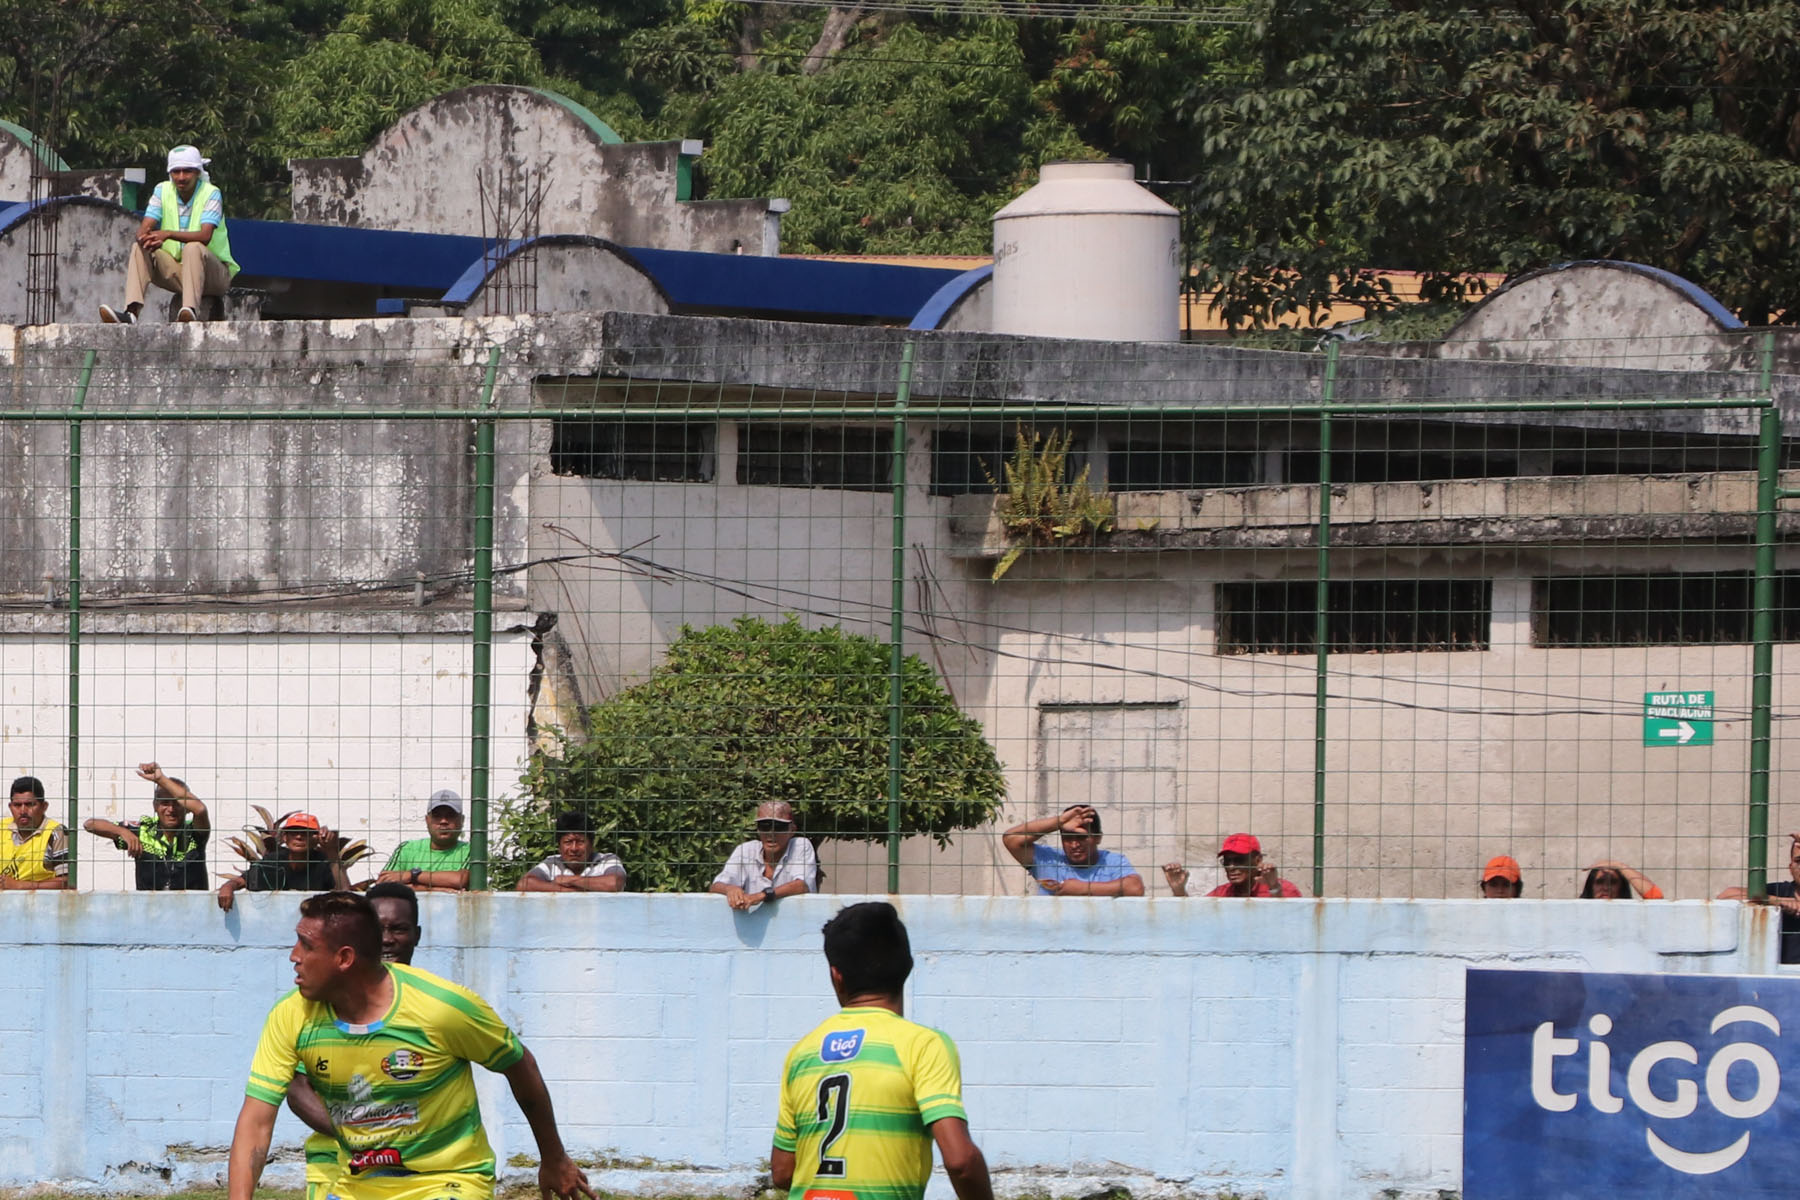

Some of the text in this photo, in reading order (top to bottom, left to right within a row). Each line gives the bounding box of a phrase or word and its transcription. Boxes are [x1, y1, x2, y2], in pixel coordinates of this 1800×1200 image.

[1652, 693, 1706, 705] RUTA DE
[830, 1034, 859, 1056] tigo
[1531, 1005, 1781, 1119] tigo
[816, 1072, 851, 1178] 2
